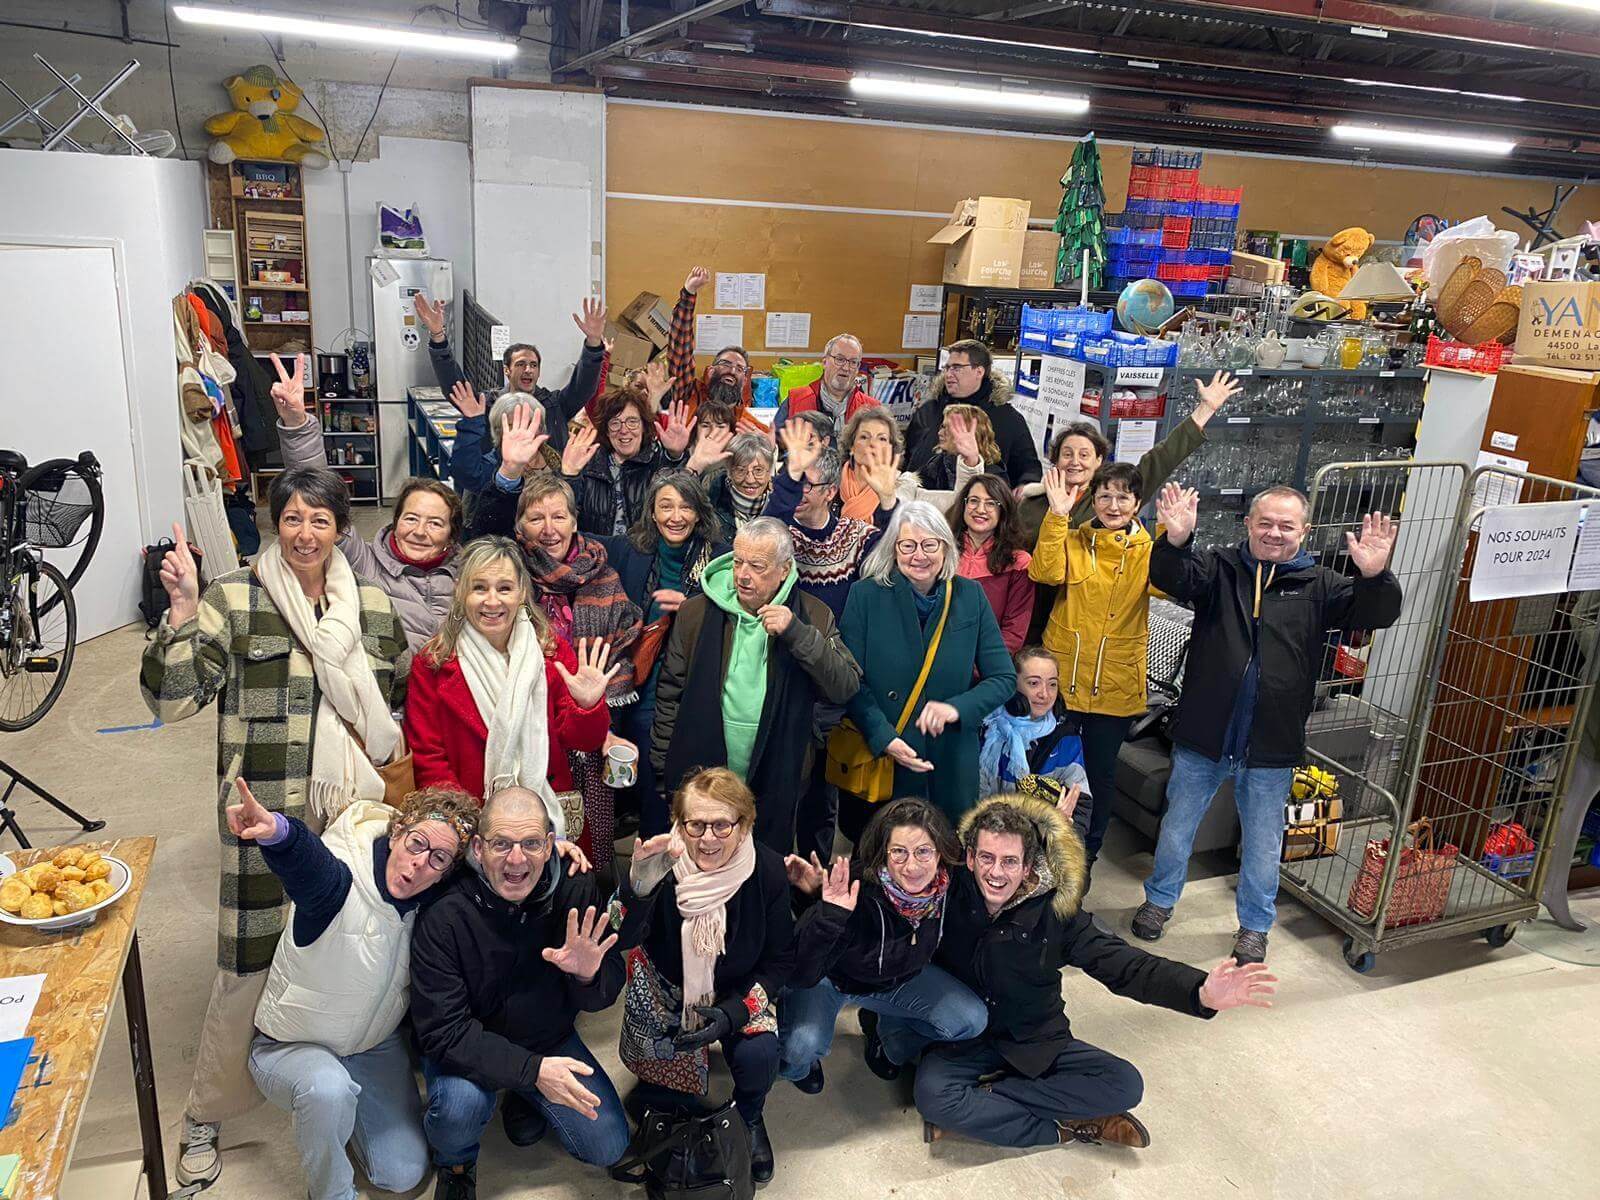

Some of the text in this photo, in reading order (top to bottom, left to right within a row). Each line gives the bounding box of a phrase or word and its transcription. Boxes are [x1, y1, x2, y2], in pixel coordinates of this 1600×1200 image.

[980, 266, 1013, 277] Fourche
[1021, 267, 1049, 277] ourche
[1547, 341, 1599, 351] 44500 La
[1120, 372, 1160, 380] VAISSELLE
[1487, 526, 1567, 544] NOS SOUHAITS
[1493, 549, 1551, 564] POUR 2024
